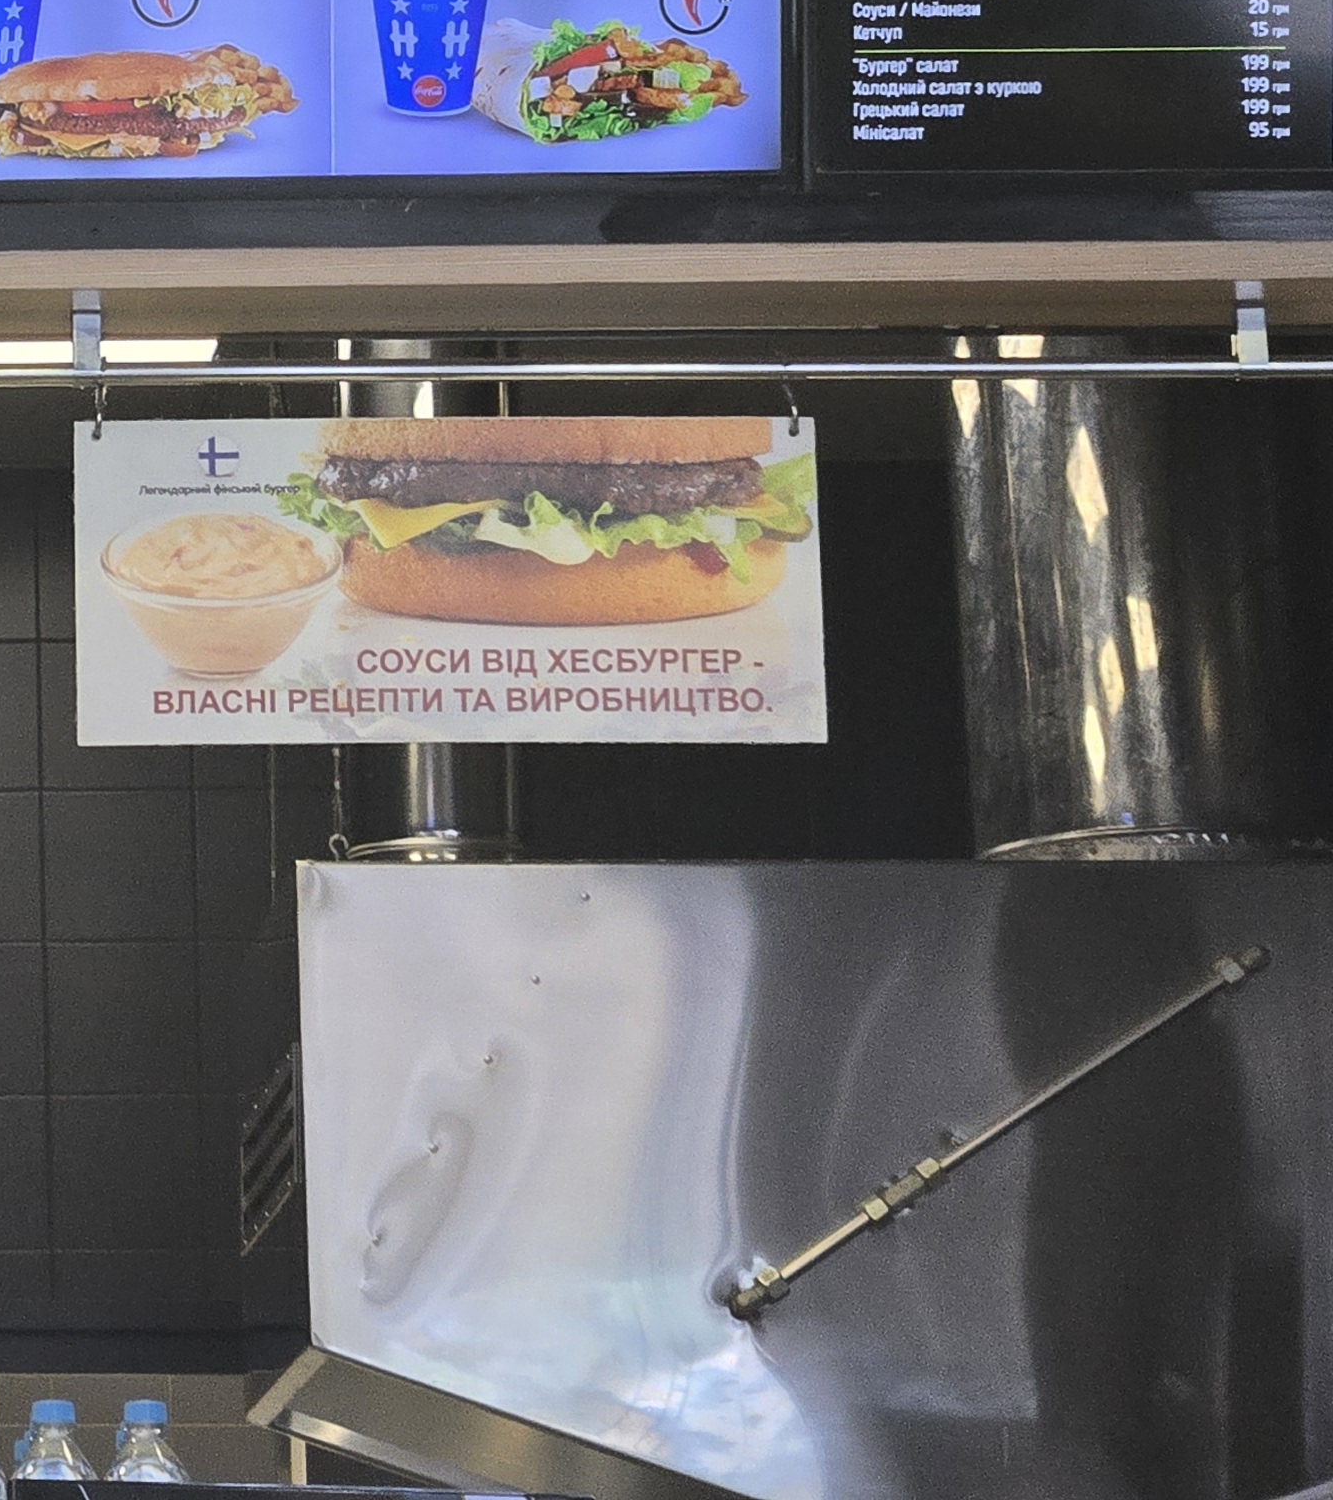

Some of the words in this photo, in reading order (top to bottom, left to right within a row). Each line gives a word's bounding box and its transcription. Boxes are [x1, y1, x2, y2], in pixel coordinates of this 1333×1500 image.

[853, 24, 902, 43] Кетчуп
[852, 101, 919, 121] Грецький
[922, 101, 965, 117] салат
[1241, 99, 1269, 115] 199
[853, 124, 924, 140] Мінісалат
[1249, 123, 1269, 138] 95
[357, 649, 472, 676] СОУСИ
[482, 648, 535, 680] ВІД
[547, 647, 742, 674] ХЕСБУРГЕР
[153, 690, 277, 715] ВЛАСНІ
[288, 689, 444, 718] РЕЦЕПТИ
[453, 689, 496, 713] ТА
[506, 686, 774, 717] ВИРОБНИЦТВО.
